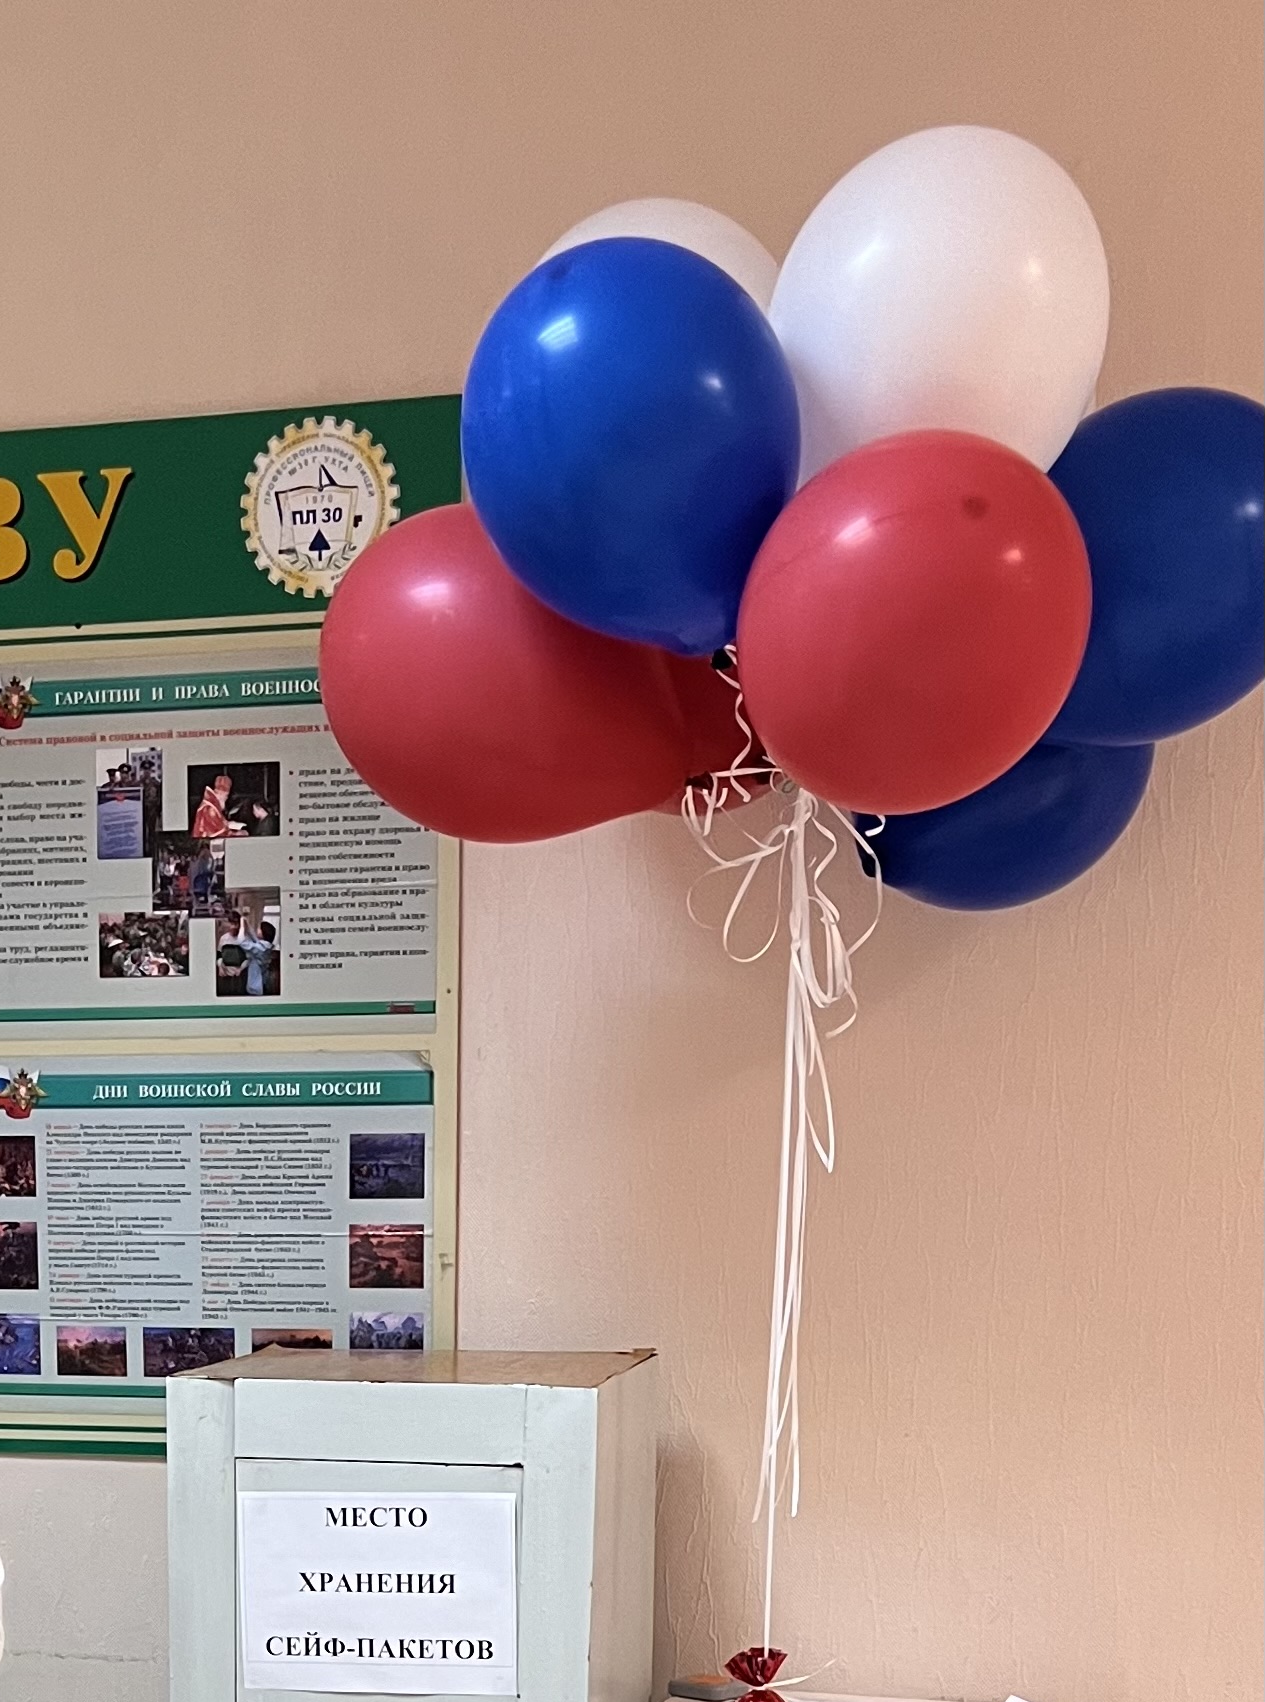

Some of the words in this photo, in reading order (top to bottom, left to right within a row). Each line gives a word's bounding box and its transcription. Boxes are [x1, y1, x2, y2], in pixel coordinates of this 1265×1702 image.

[306, 495, 333, 505] 1970
[292, 510, 317, 525] ПЛ
[322, 507, 342, 523] 30
[55, 687, 141, 706] ГАРАНТИИ
[152, 687, 164, 700] И
[175, 685, 230, 699] ПРАВА
[93, 1085, 128, 1100] ДНИ
[138, 1080, 231, 1099] ВОИНСКОЙ
[242, 1082, 301, 1097] СЛАВЫ
[311, 1081, 381, 1096] РОССИИ
[325, 1506, 428, 1528] МЕСТО
[298, 1572, 456, 1594] ХРАНЕНИЯ
[265, 1631, 494, 1661] СЕЙФ-ПАКЕТОВ
